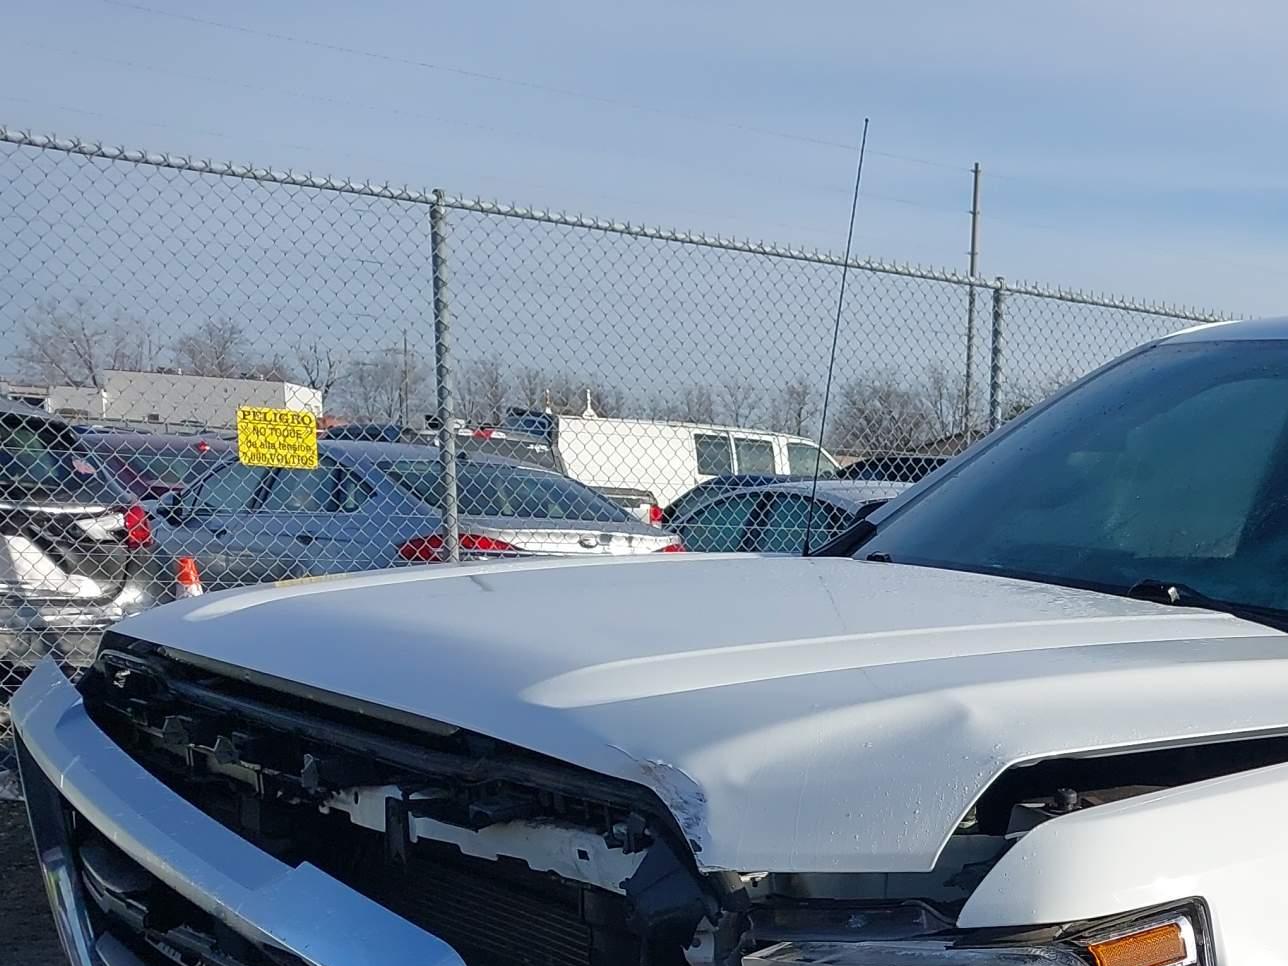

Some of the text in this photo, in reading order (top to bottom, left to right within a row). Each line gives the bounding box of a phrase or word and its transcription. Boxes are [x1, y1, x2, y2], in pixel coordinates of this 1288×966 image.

[242, 410, 312, 425] PELIGRO
[252, 426, 303, 440] NO TOQUE
[269, 453, 315, 466] VOLTIOS
